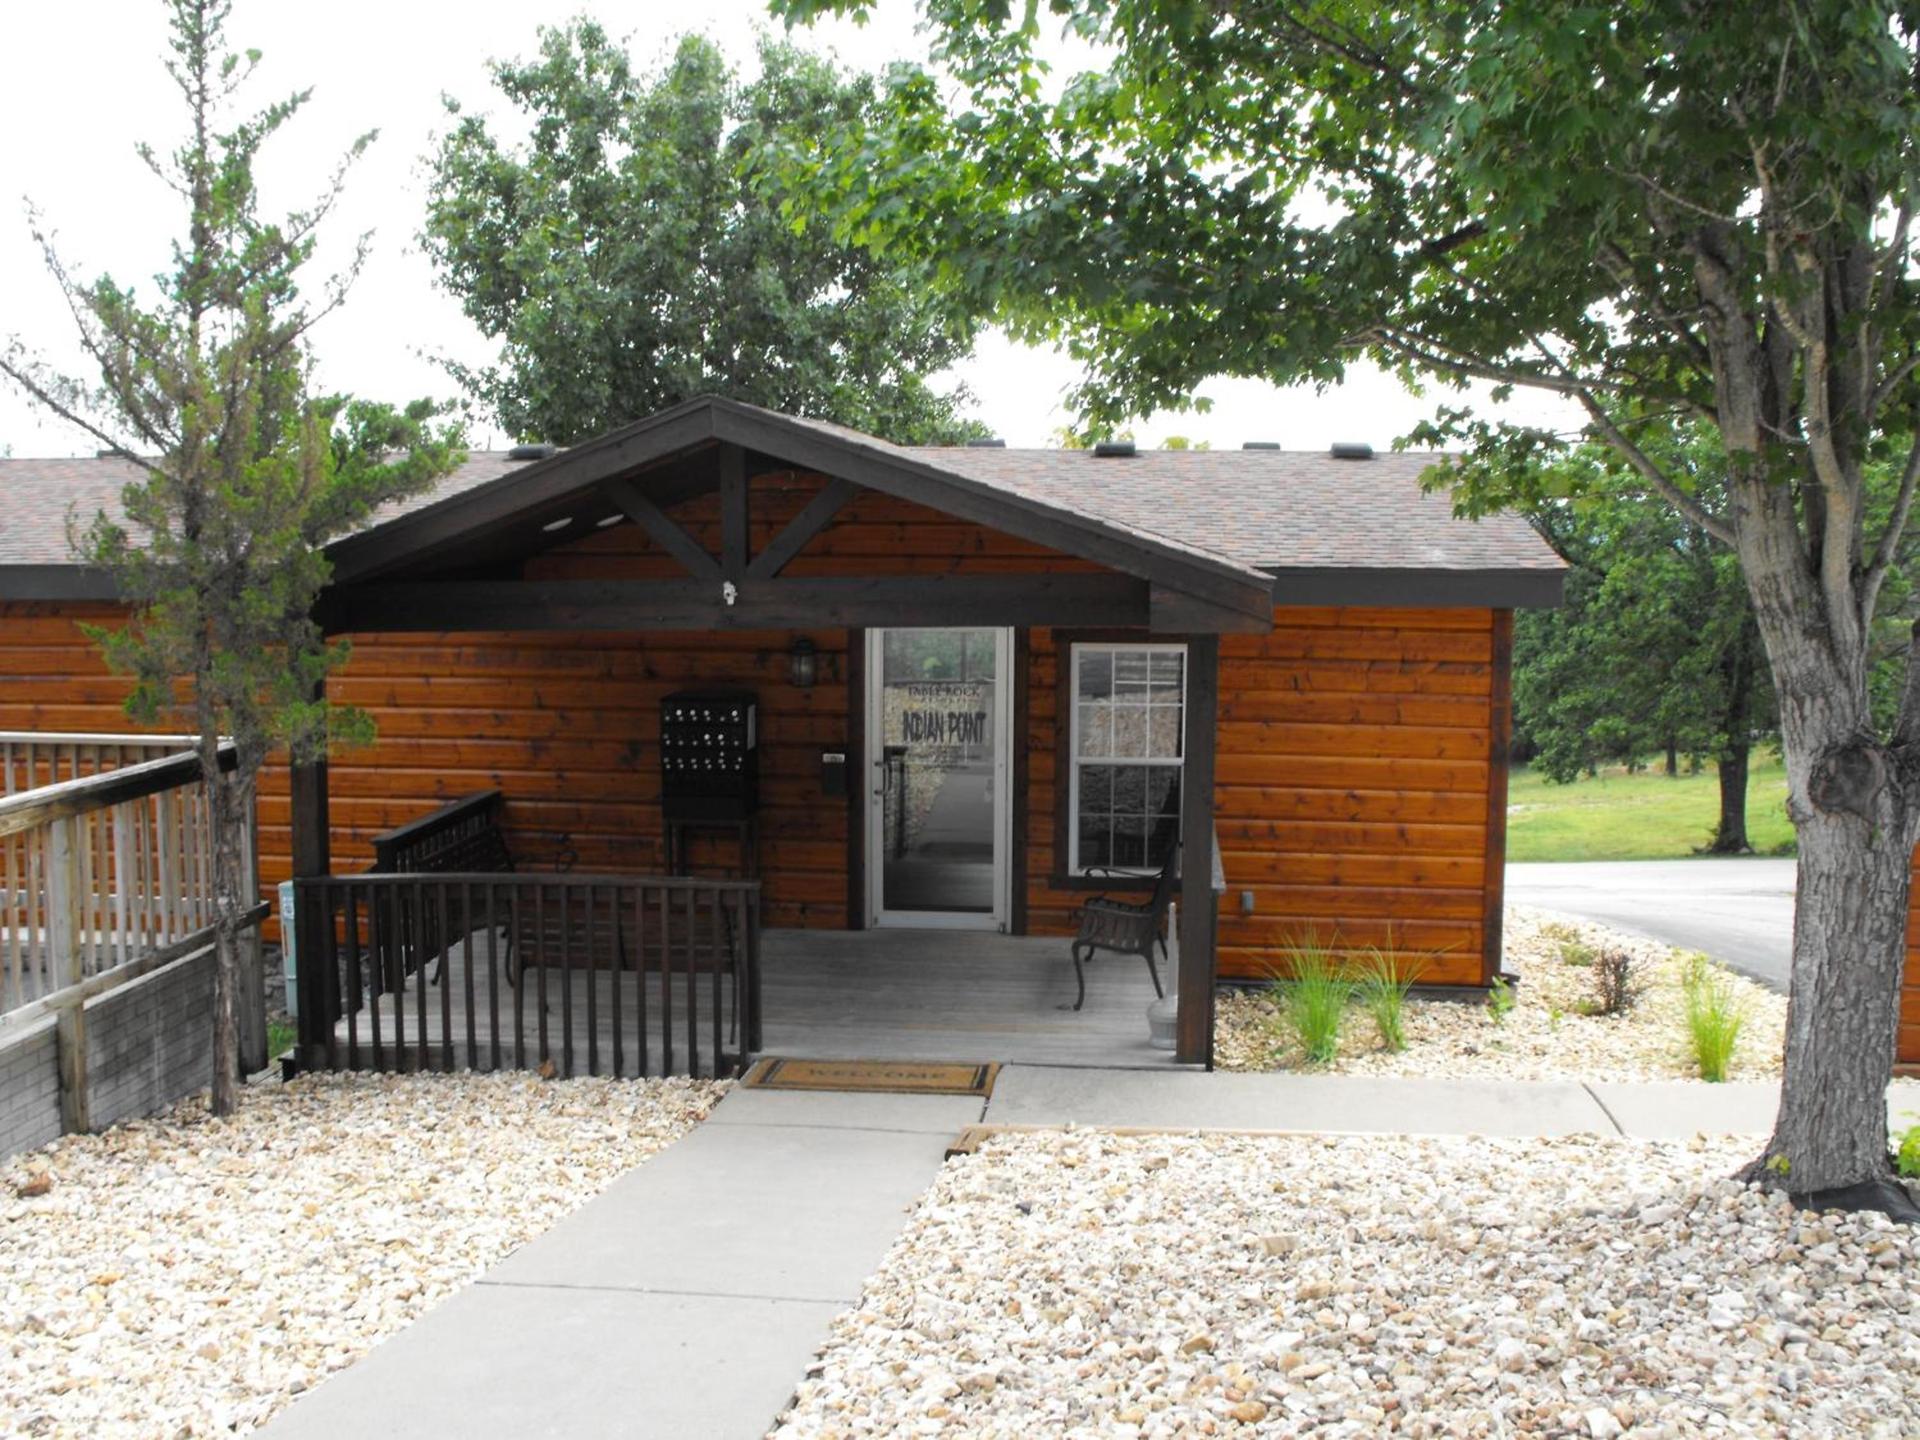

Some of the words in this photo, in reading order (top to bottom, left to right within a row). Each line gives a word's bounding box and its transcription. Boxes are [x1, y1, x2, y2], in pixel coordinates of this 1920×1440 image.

[902, 710, 944, 744] INDIAN
[947, 711, 987, 744] POINT
[809, 1067, 946, 1078] WELCOME
